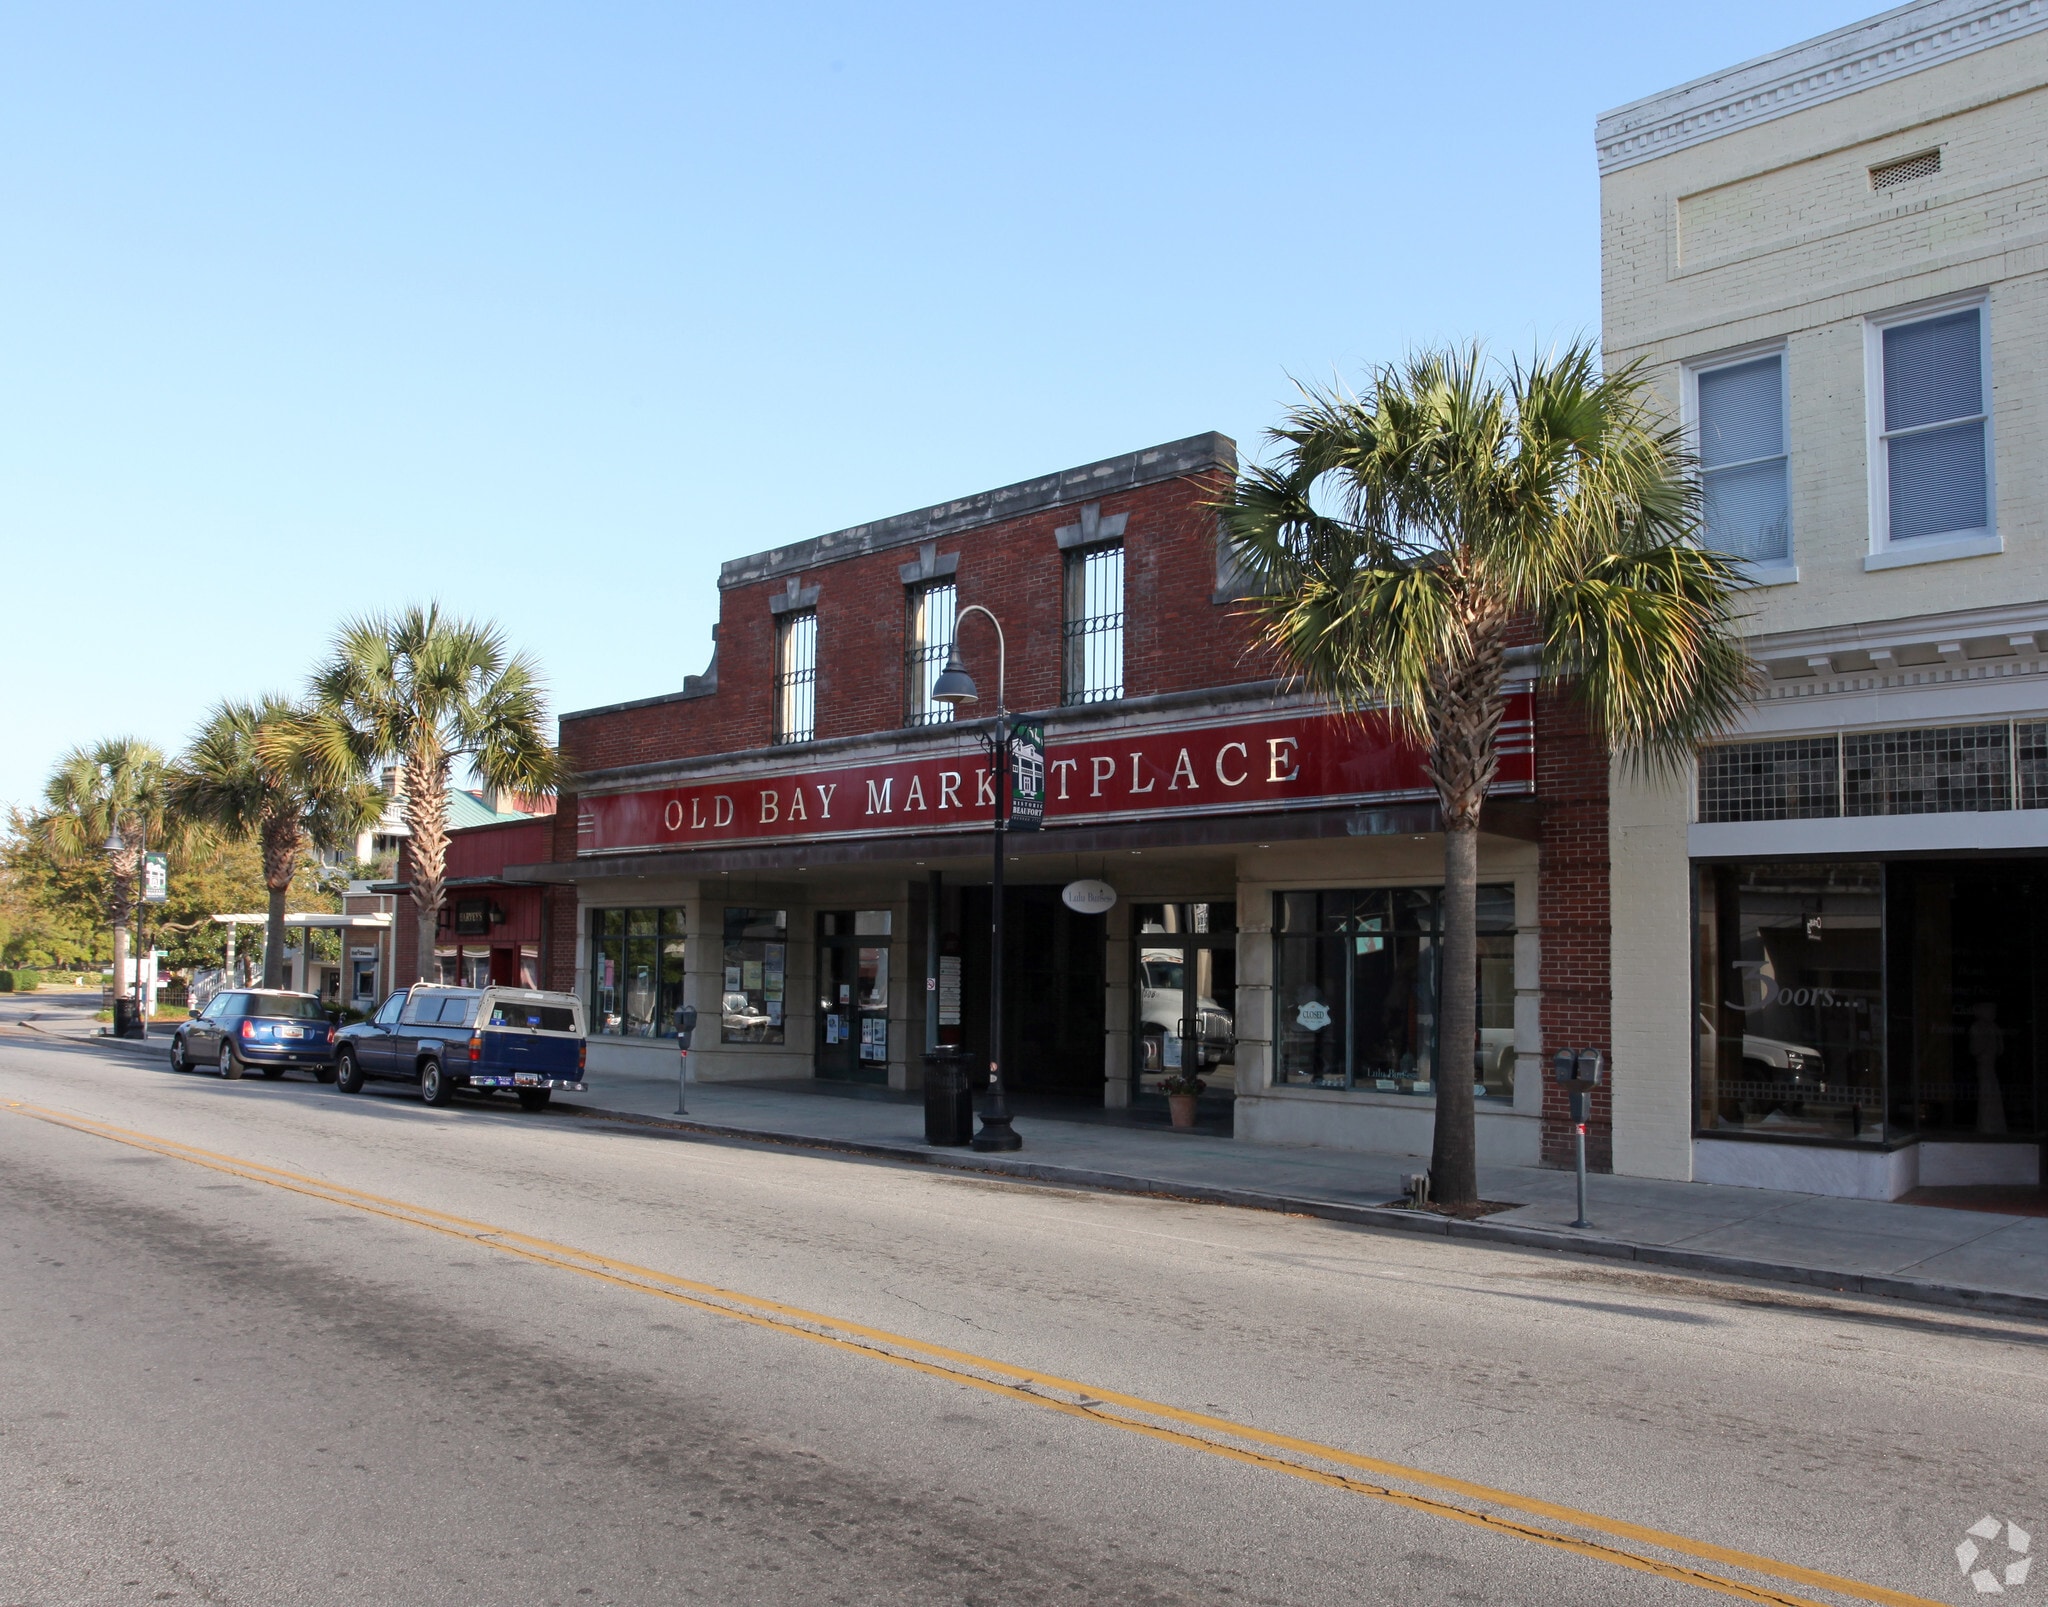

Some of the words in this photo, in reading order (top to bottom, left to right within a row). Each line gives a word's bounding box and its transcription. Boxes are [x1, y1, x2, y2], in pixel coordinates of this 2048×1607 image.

[664, 795, 734, 832] OLD
[759, 783, 837, 824] BAY
[865, 736, 1300, 816] MARKTPLACE
[1012, 800, 1043, 809] HISTORIC
[1012, 806, 1043, 817] BEAUFORT
[1302, 1010, 1325, 1019] CLOSED
